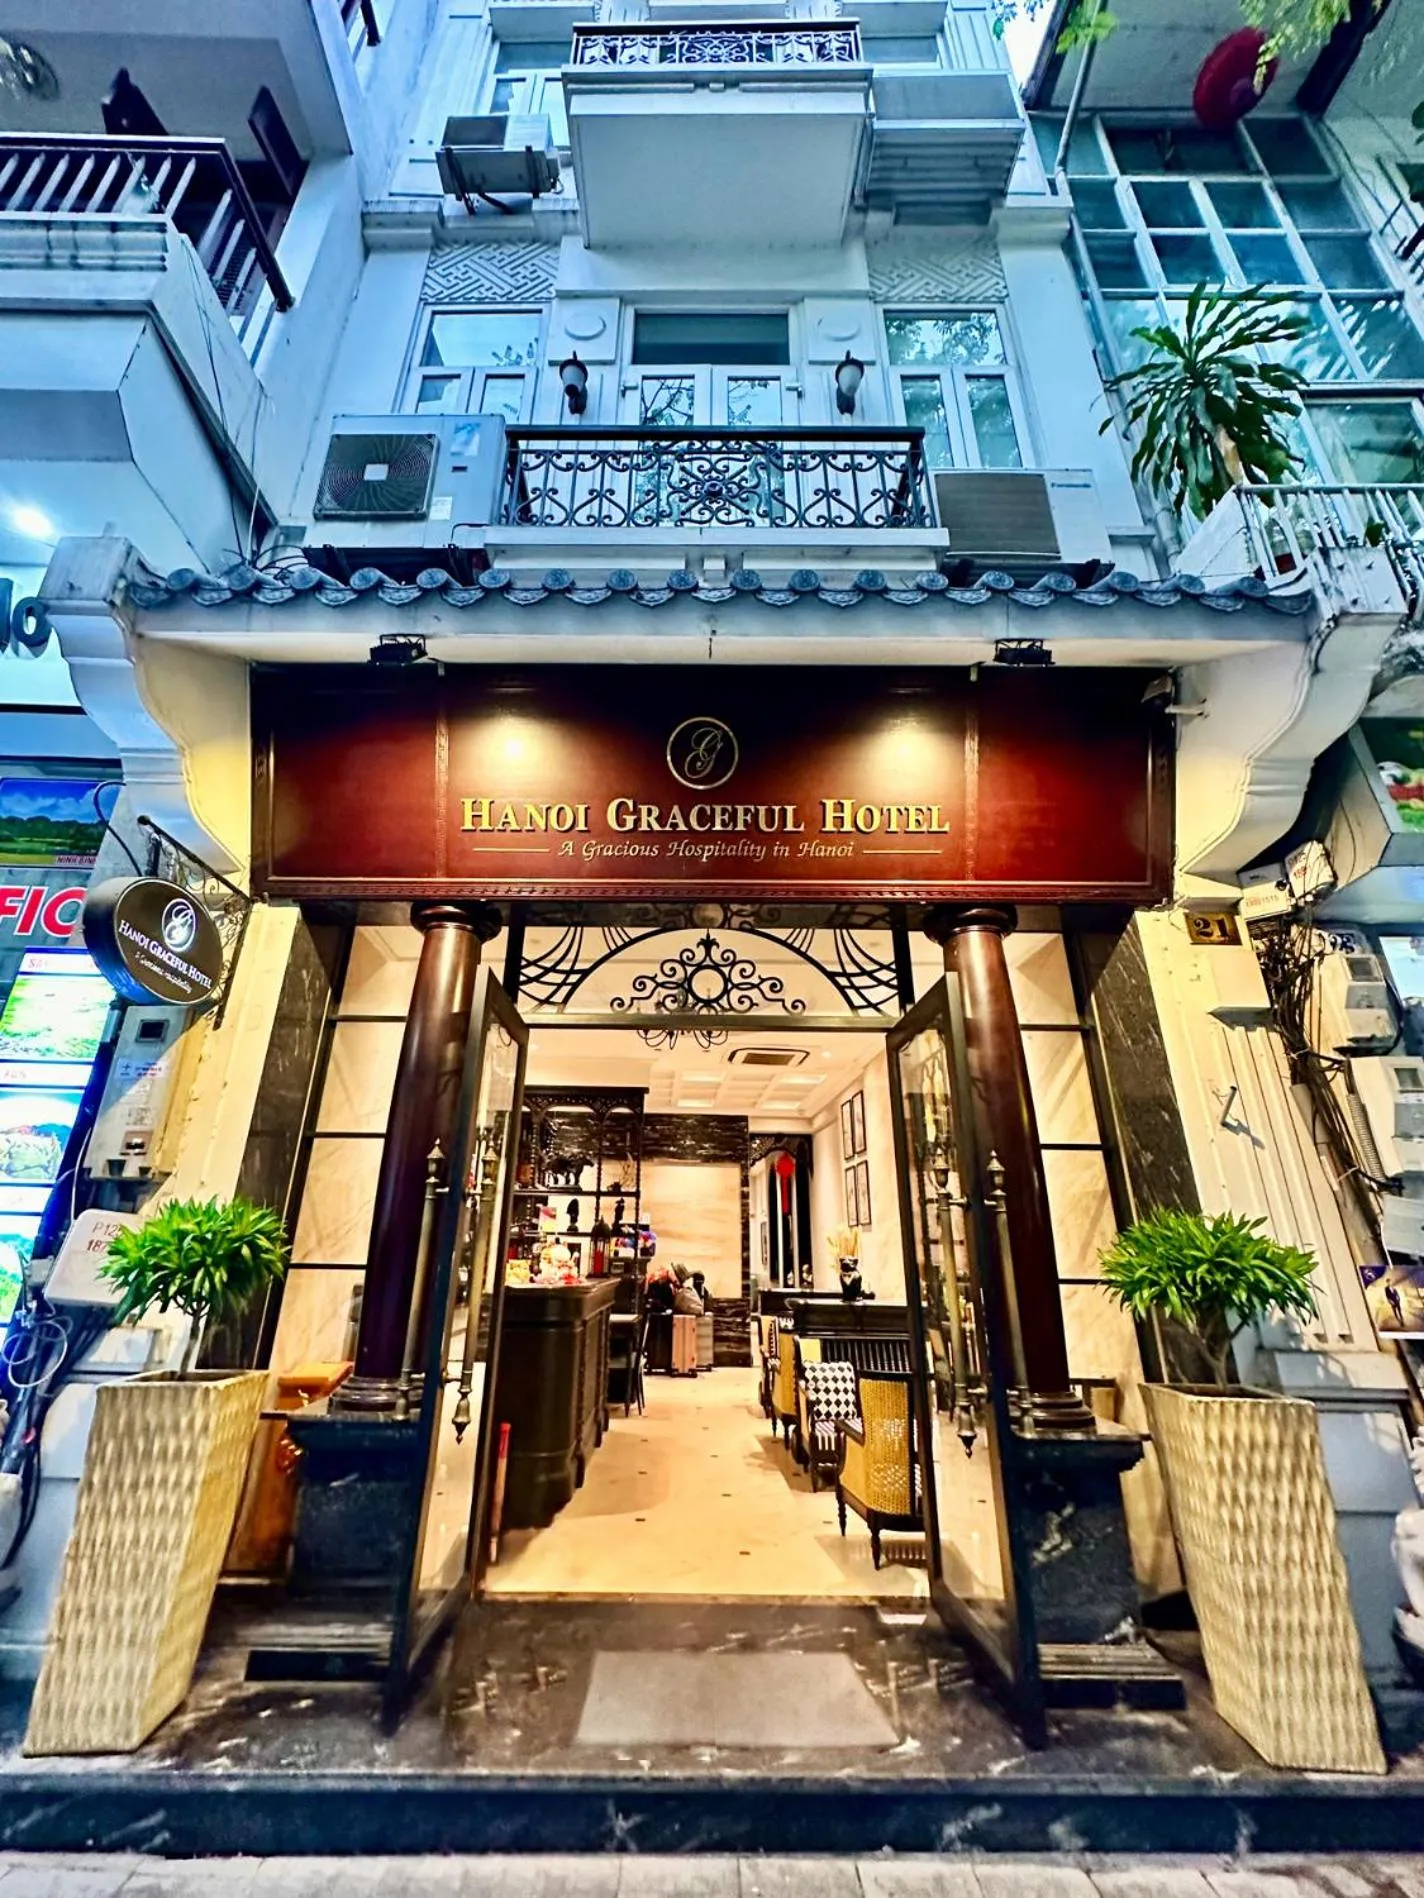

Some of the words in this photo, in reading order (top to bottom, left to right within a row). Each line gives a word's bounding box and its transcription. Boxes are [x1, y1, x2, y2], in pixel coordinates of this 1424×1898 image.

[460, 797, 590, 832] HANOI
[606, 797, 805, 833] GRACEFUL
[821, 798, 950, 832] HOTEL
[557, 840, 574, 857] A
[582, 839, 659, 861] Gracious
[665, 839, 766, 863] Hospitality
[773, 840, 790, 857] in
[796, 839, 854, 858] Hanoi
[1193, 916, 1230, 937] 21
[118, 920, 150, 949] HANOI
[149, 940, 189, 975] GRACEFUL
[188, 965, 212, 989] HOTEL
